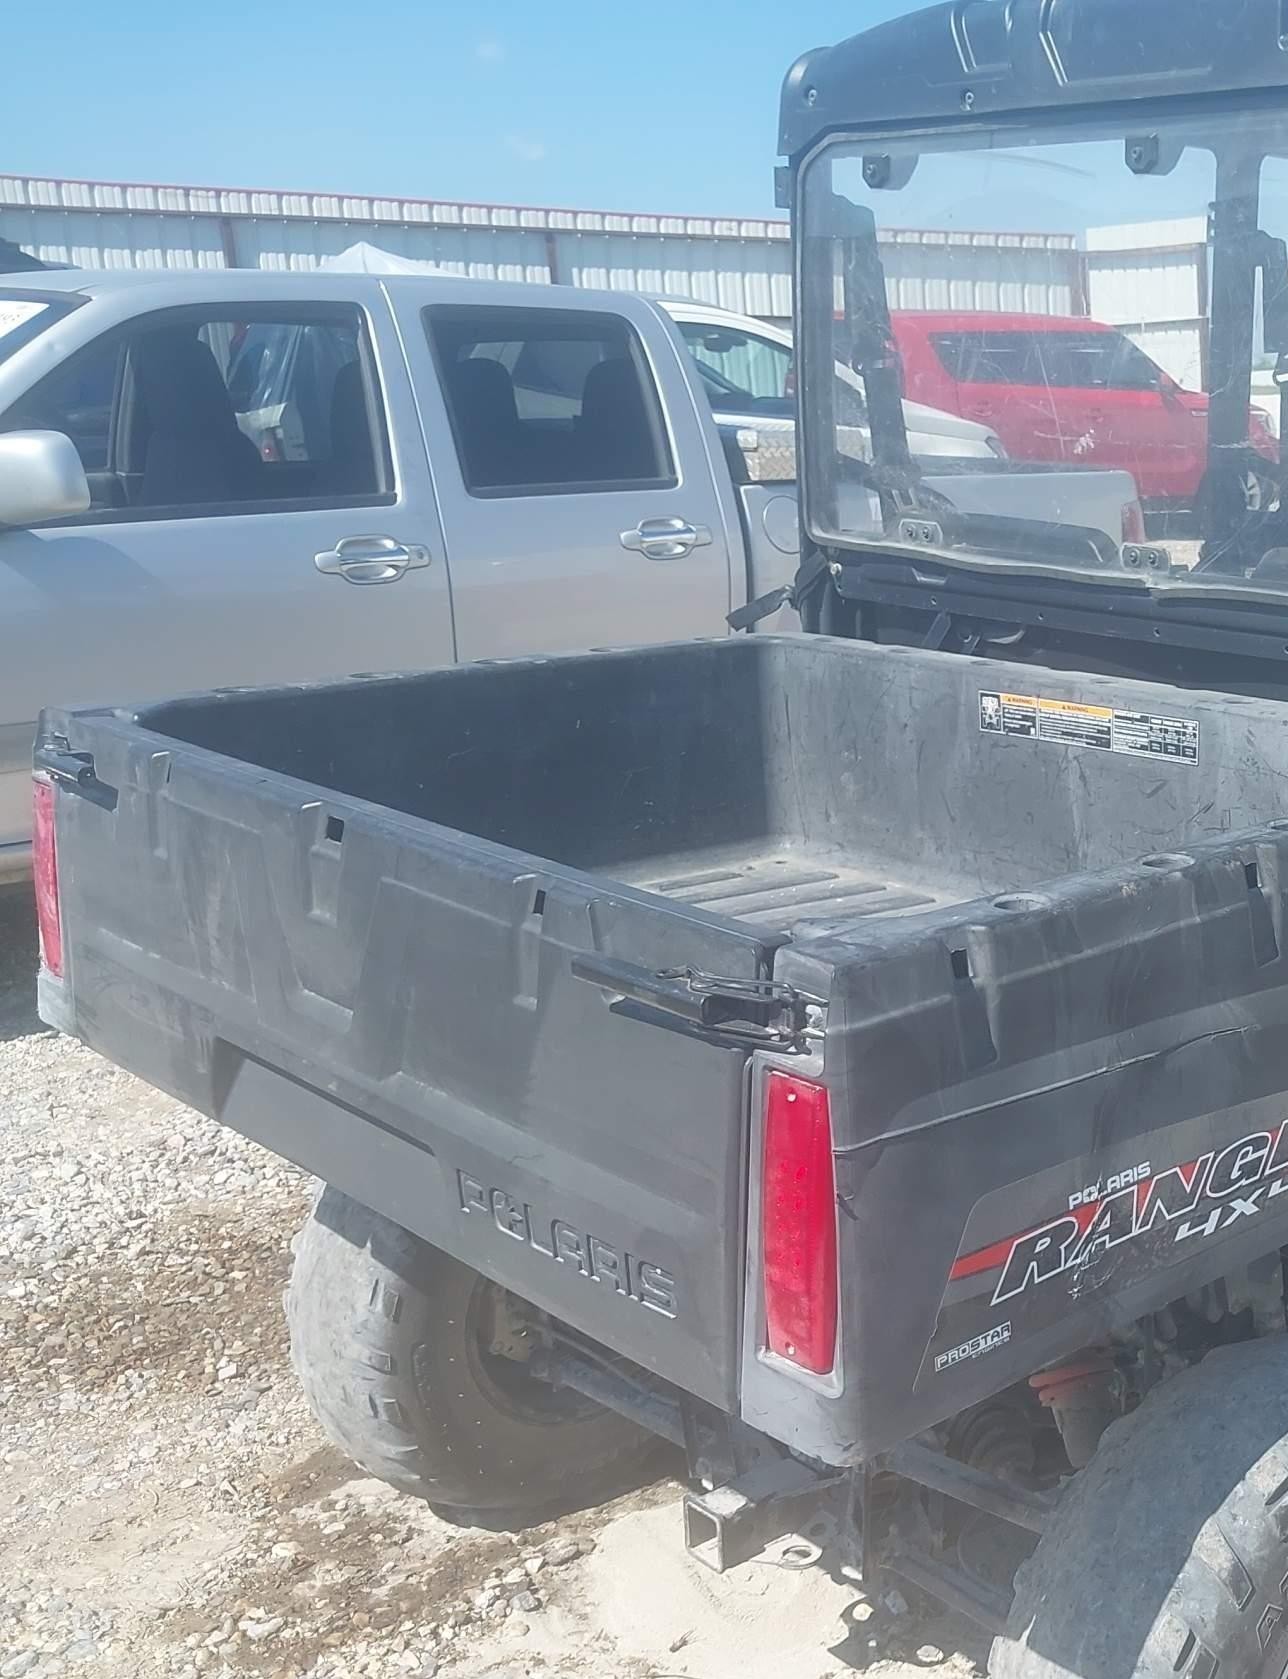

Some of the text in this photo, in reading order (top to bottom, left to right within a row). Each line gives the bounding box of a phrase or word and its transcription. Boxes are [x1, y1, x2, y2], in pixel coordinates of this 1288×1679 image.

[1068, 1161, 1152, 1210] POLARIS
[456, 1168, 678, 1319] POLARIS
[935, 1321, 1011, 1371] PROSTAR
